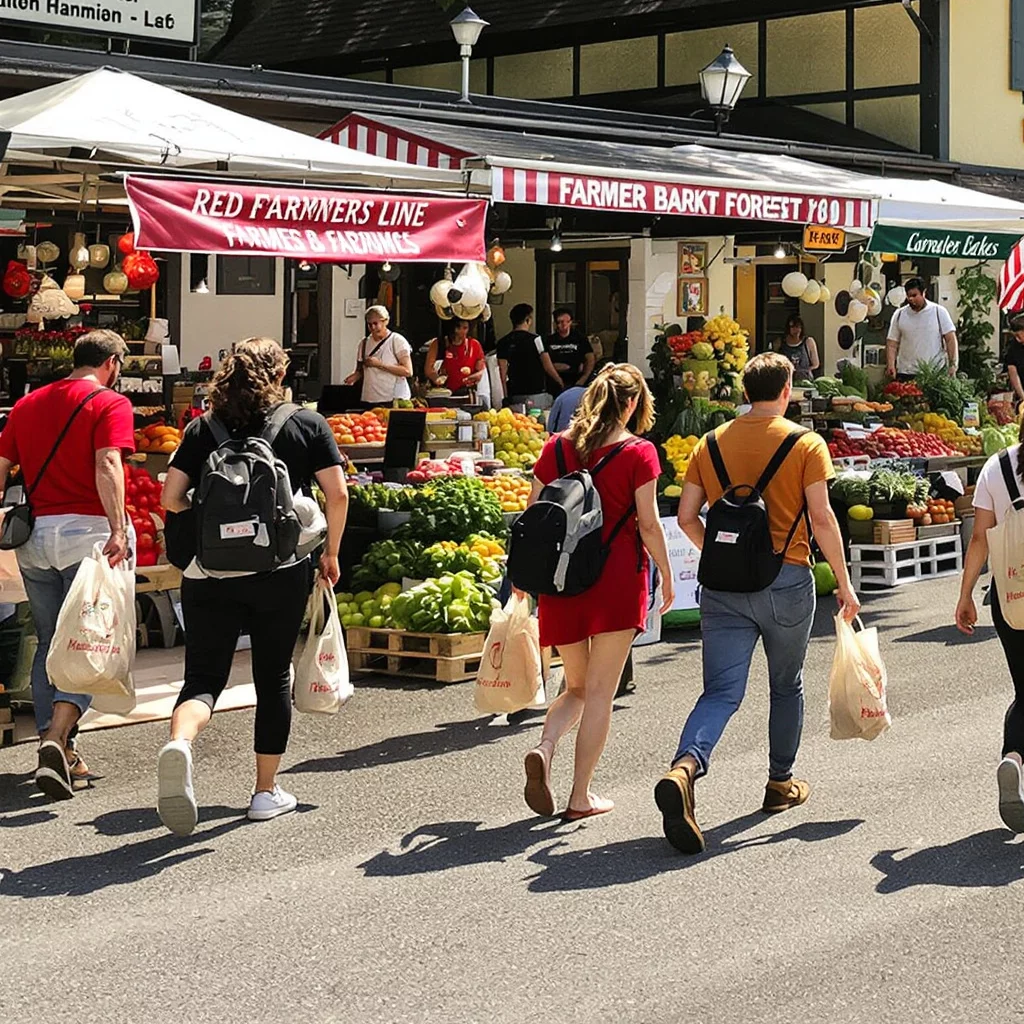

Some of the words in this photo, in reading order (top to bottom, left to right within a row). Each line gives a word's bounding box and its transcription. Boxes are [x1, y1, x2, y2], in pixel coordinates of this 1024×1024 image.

[191, 188, 244, 218] RED
[377, 200, 429, 227] LINE
[559, 177, 648, 210] FARMER
[653, 184, 720, 215] BARKT
